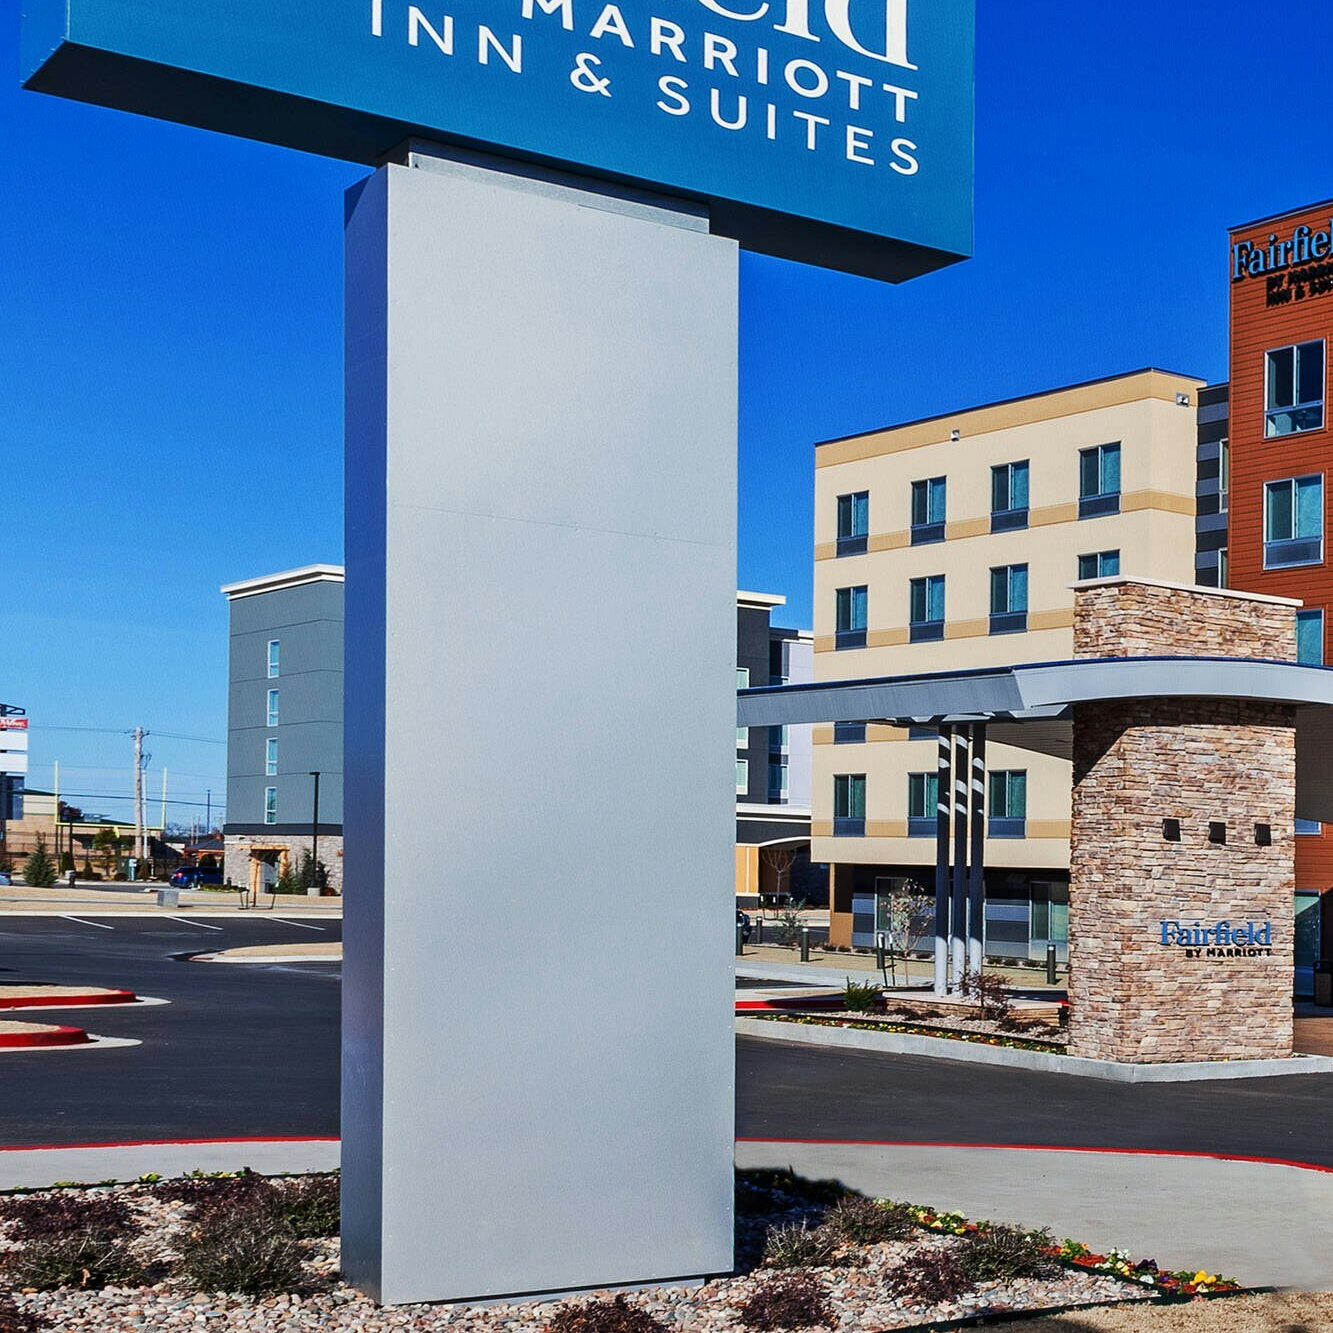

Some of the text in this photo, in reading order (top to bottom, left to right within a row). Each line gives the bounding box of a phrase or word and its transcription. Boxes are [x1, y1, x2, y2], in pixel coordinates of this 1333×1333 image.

[570, 52, 612, 97] &
[656, 75, 920, 175] SUITES
[1160, 921, 1272, 946] Fairfield
[1185, 948, 1272, 958] BY MARRIOTT
